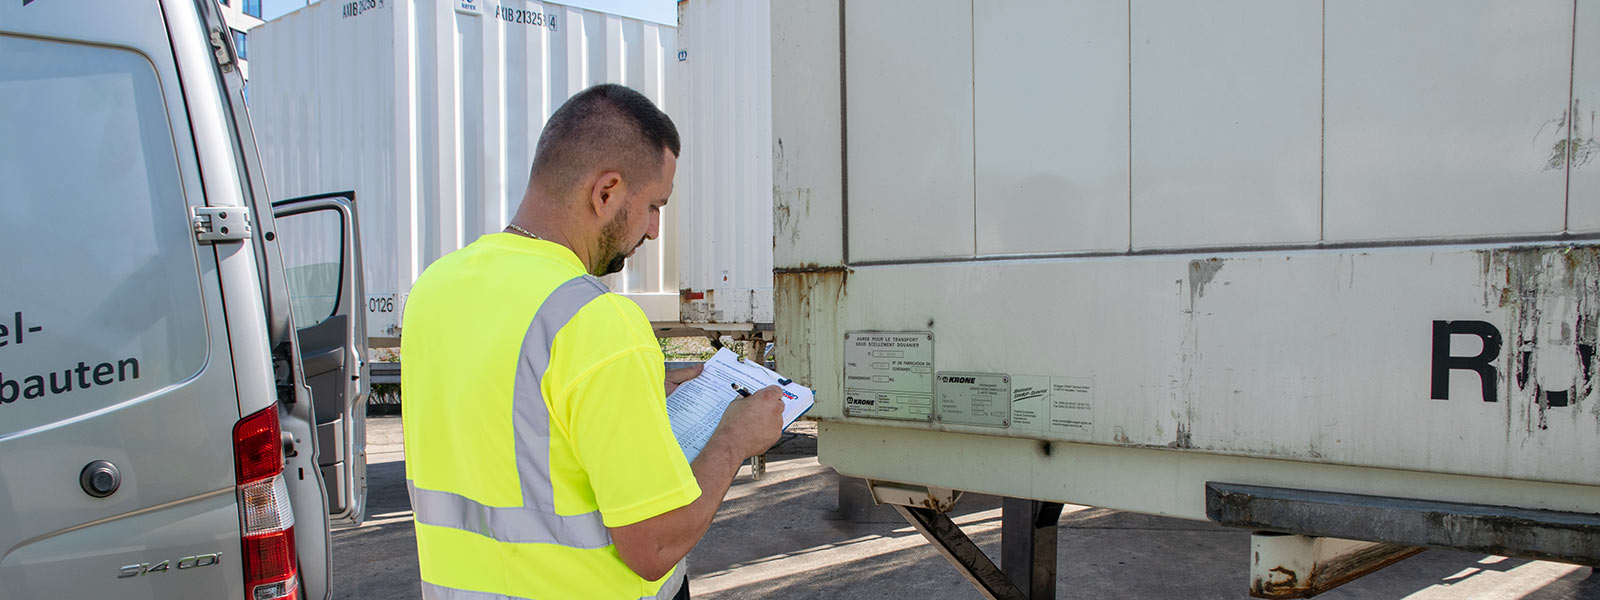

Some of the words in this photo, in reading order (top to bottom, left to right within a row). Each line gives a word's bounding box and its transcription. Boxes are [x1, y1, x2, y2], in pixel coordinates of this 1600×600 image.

[495, 4, 514, 22] AXIB
[369, 297, 393, 312] 0126
[949, 376, 976, 384] KRONE
[118, 560, 170, 579] 314
[177, 552, 223, 570] CDI
